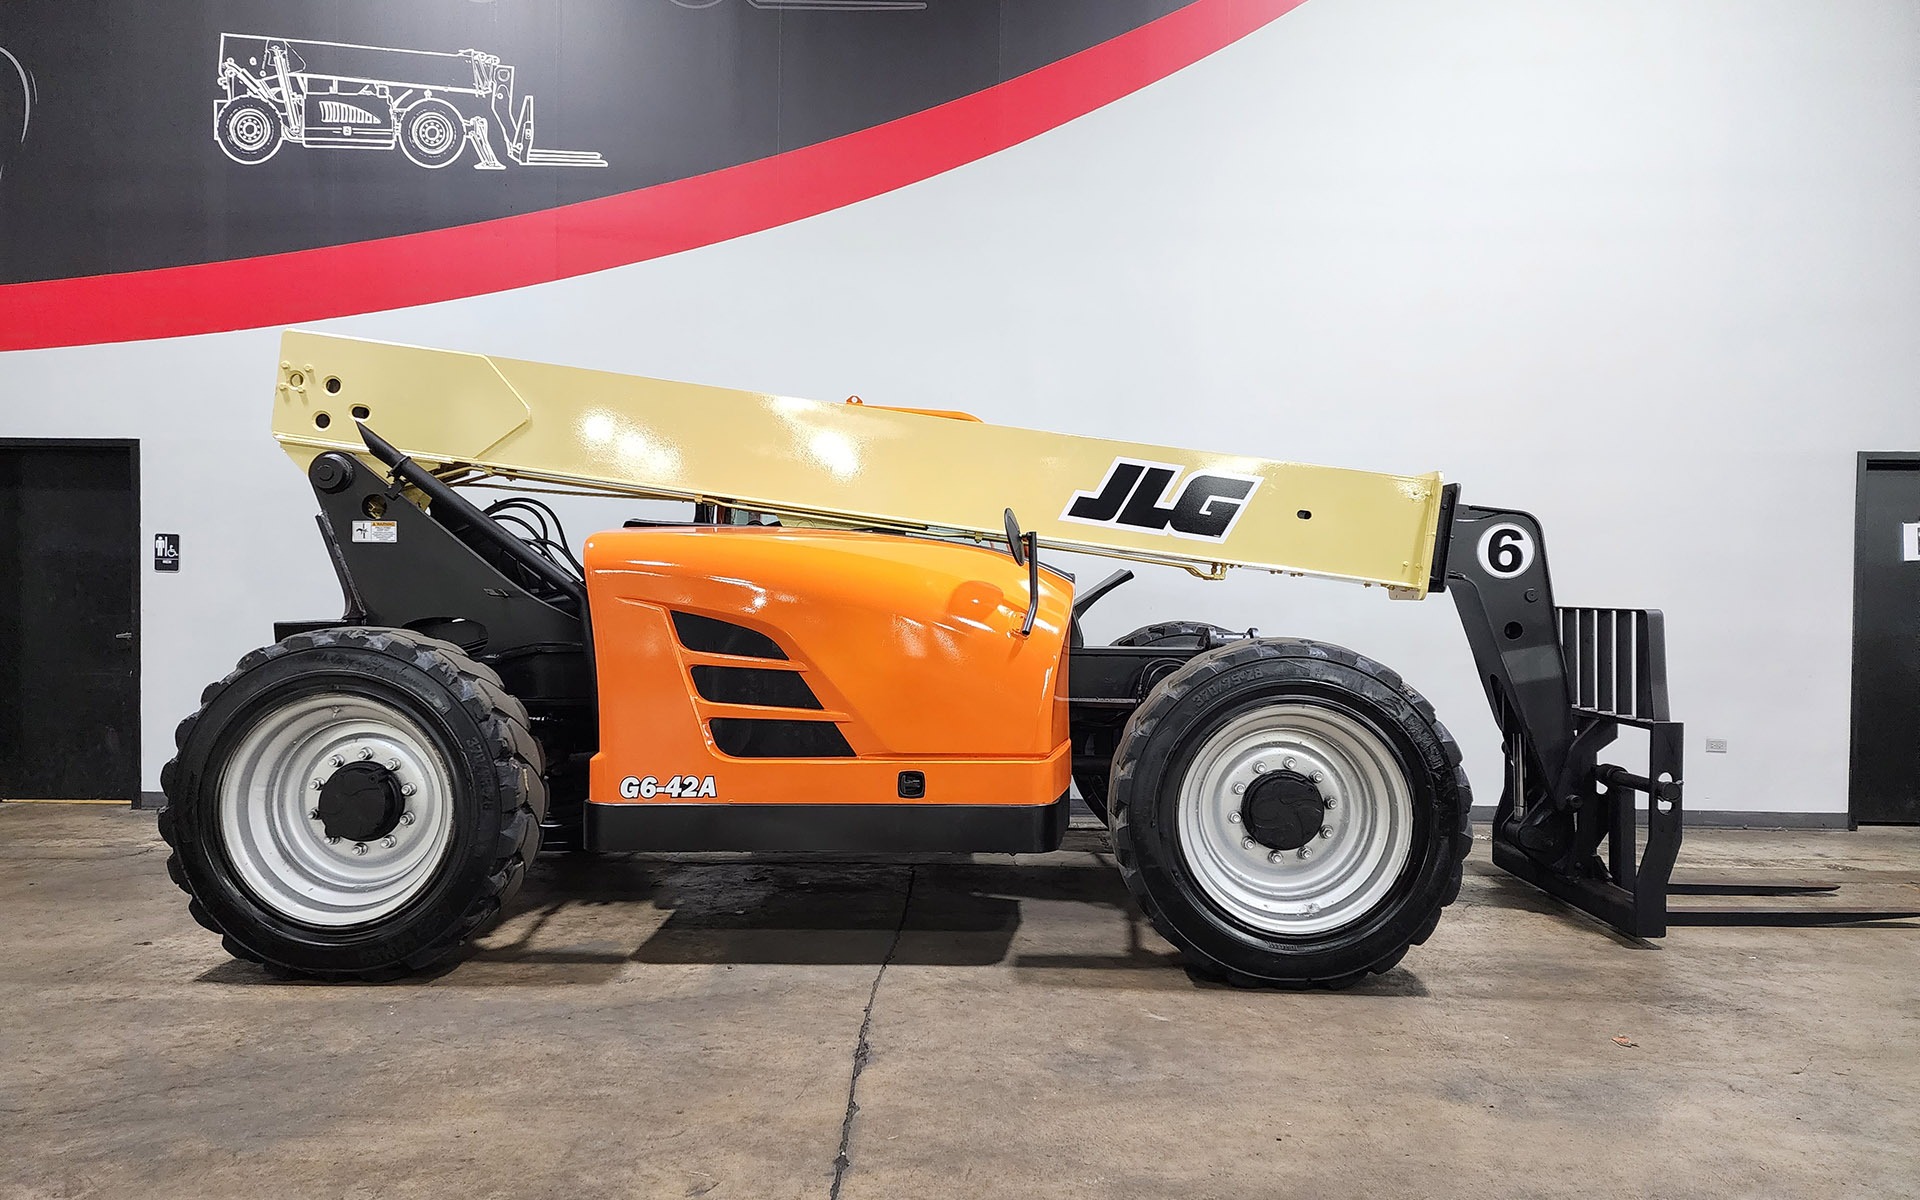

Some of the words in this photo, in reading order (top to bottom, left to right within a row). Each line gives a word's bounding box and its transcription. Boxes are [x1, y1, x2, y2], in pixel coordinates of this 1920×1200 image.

[1067, 462, 1255, 538] JLG
[1488, 529, 1524, 573] 6
[619, 775, 717, 799] G6-42A
